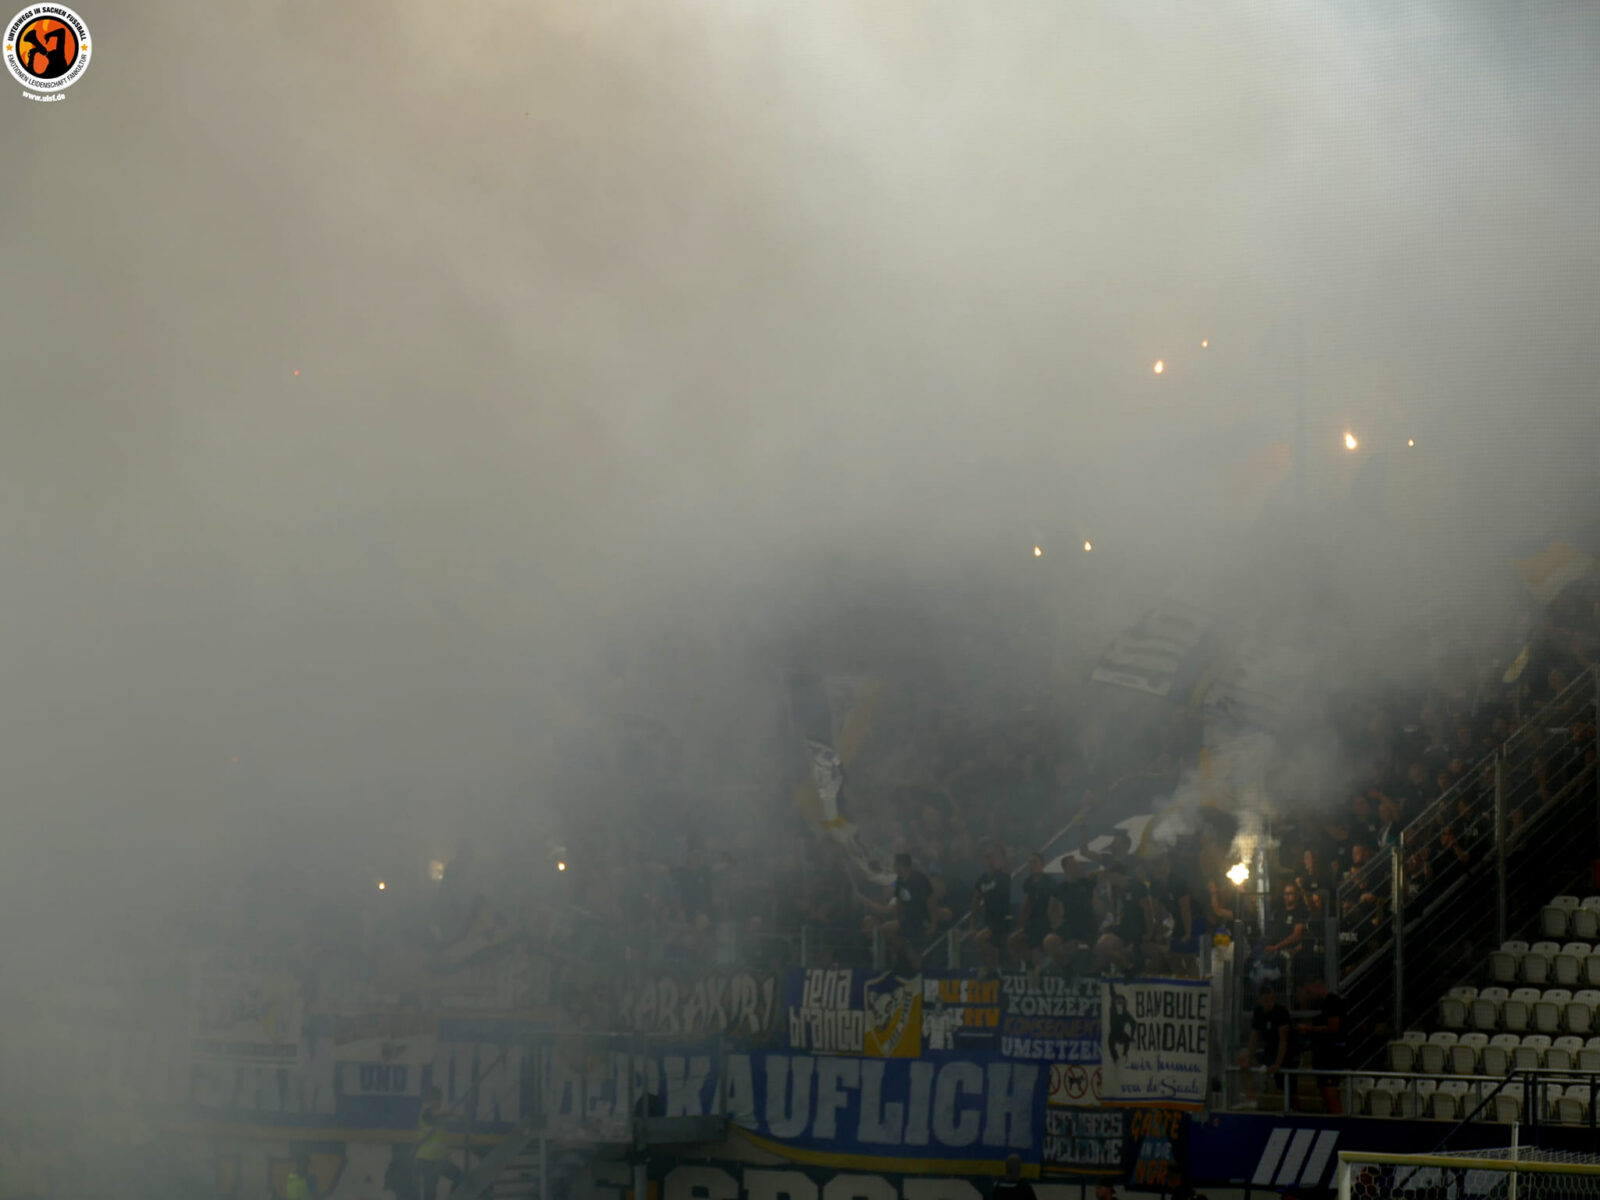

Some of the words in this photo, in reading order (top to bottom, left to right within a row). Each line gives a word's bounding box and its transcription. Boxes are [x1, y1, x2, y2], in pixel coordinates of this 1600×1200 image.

[1007, 995, 1102, 1016] KONZEPT
[789, 1005, 865, 1052] branco
[1001, 1036, 1103, 1061] UMSETZEN
[359, 1063, 409, 1093] UND
[1043, 1135, 1123, 1164] WELCOME
[1135, 1159, 1182, 1187] NOR
